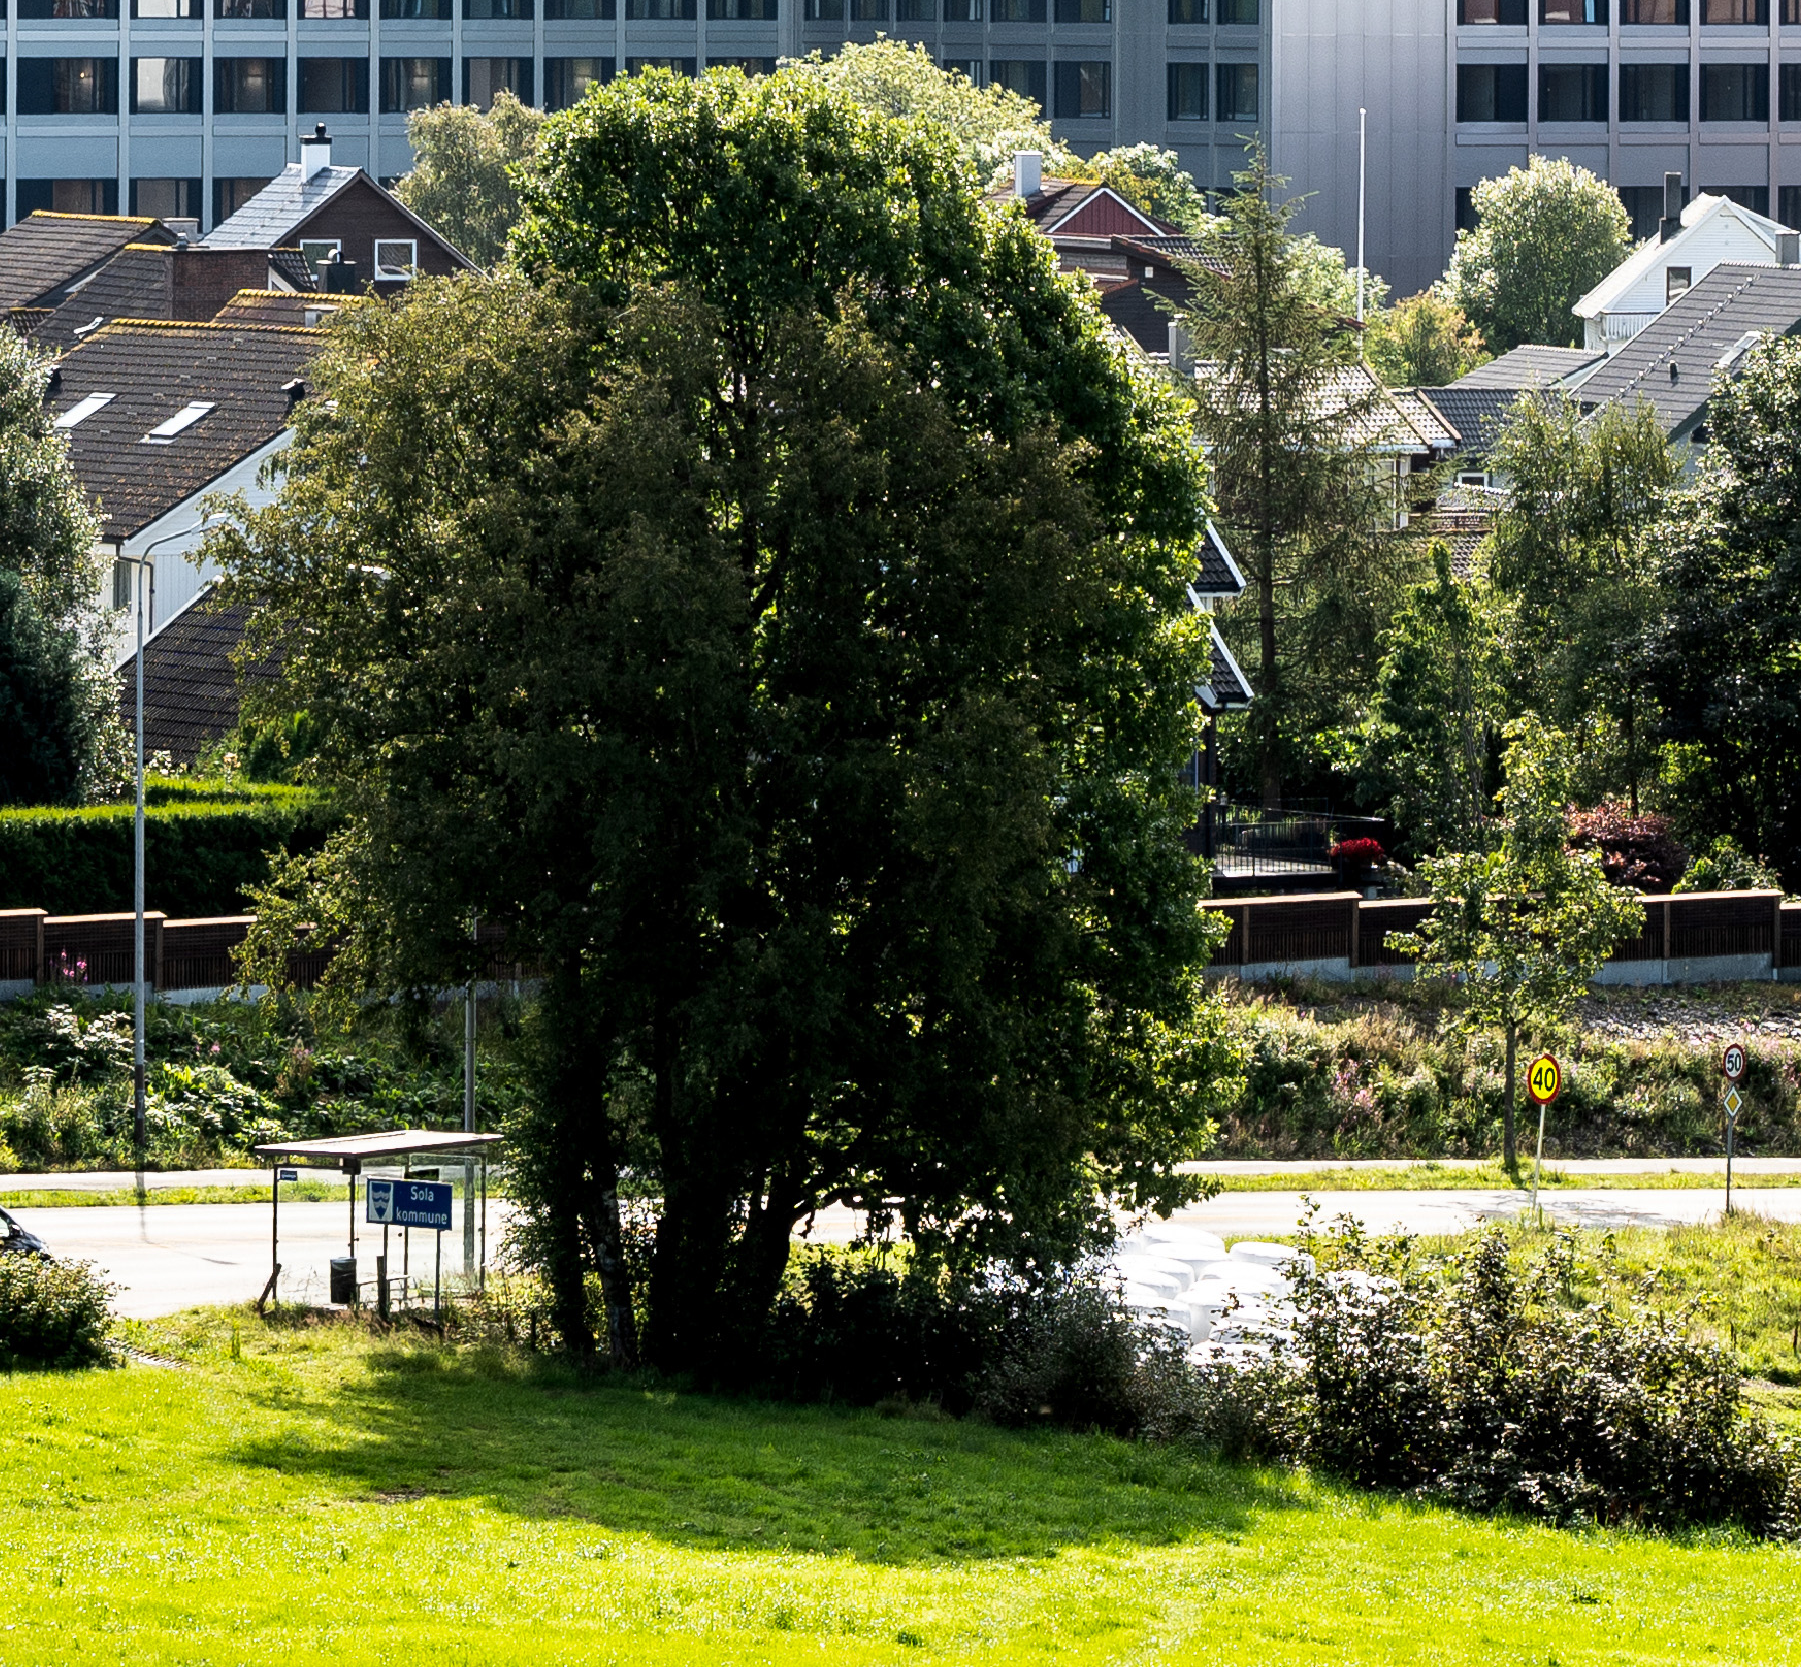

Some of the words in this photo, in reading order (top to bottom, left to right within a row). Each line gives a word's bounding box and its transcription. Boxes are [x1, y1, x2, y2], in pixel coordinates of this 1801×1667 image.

[1726, 1052, 1742, 1073] 50
[1532, 1067, 1556, 1092] 40
[410, 1185, 435, 1202] Sola
[395, 1206, 448, 1226] kommune
